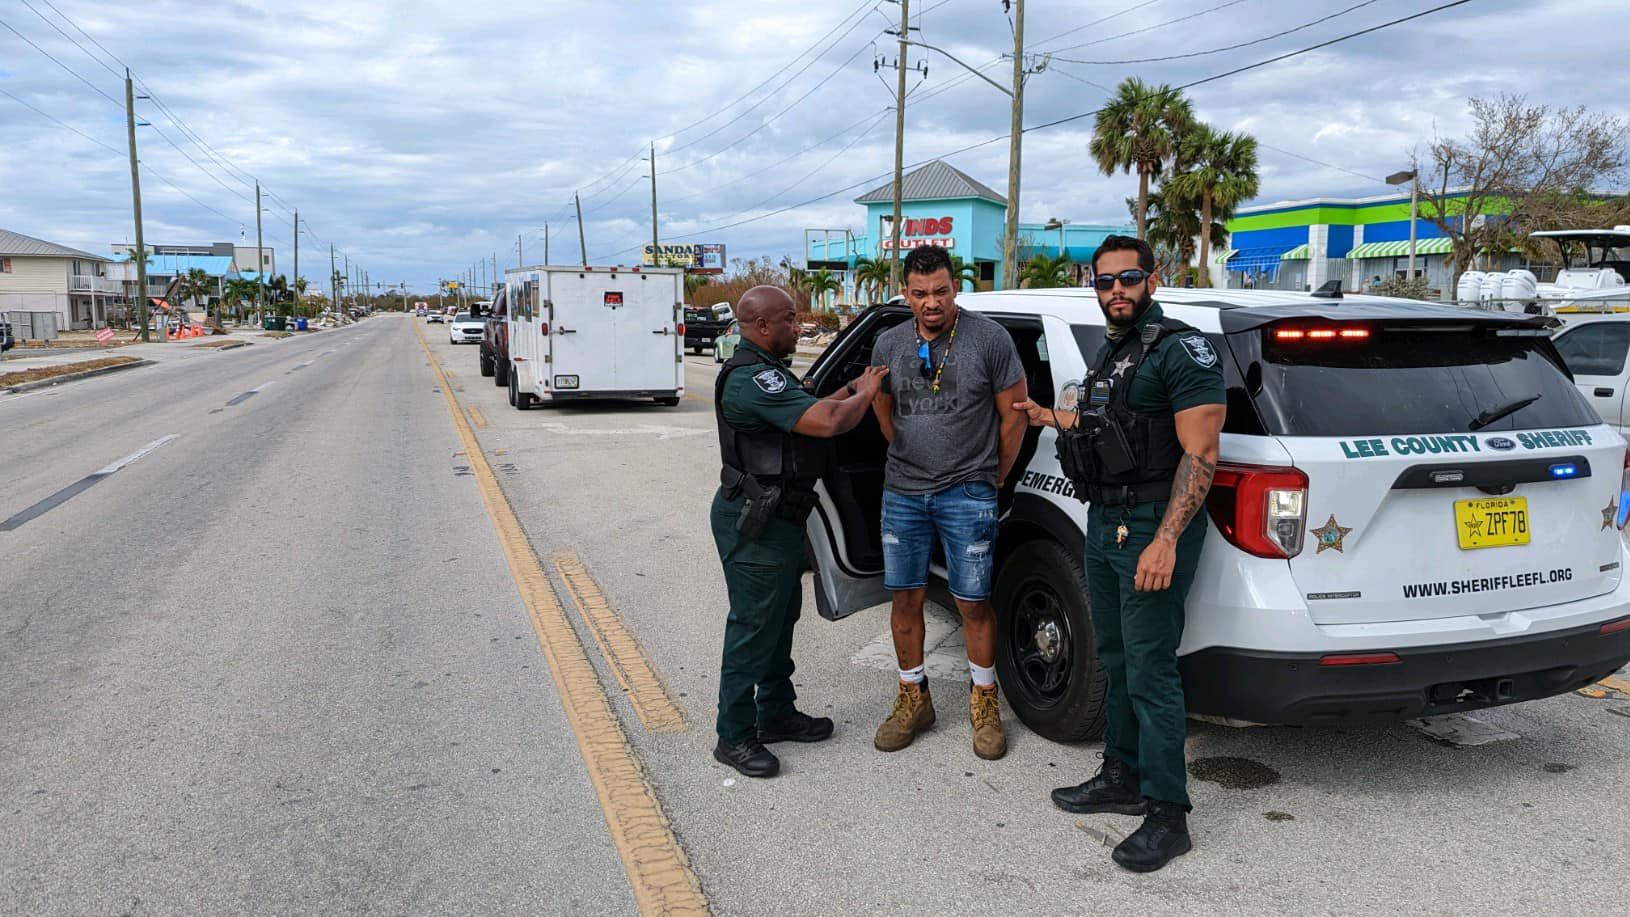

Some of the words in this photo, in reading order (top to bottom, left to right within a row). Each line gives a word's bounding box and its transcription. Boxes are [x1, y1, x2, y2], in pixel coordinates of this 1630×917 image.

[645, 245, 695, 254] SANDA
[1340, 439, 1389, 459] LEE
[1391, 435, 1480, 456] COUNTY
[1516, 430, 1592, 450] SHERIFF
[1021, 470, 1077, 498] EMERG
[1475, 501, 1508, 509] FLORIDA
[1485, 510, 1526, 536] ZPF78
[1402, 568, 1573, 599] WWW.SHERIFFLEEFL.ORG
